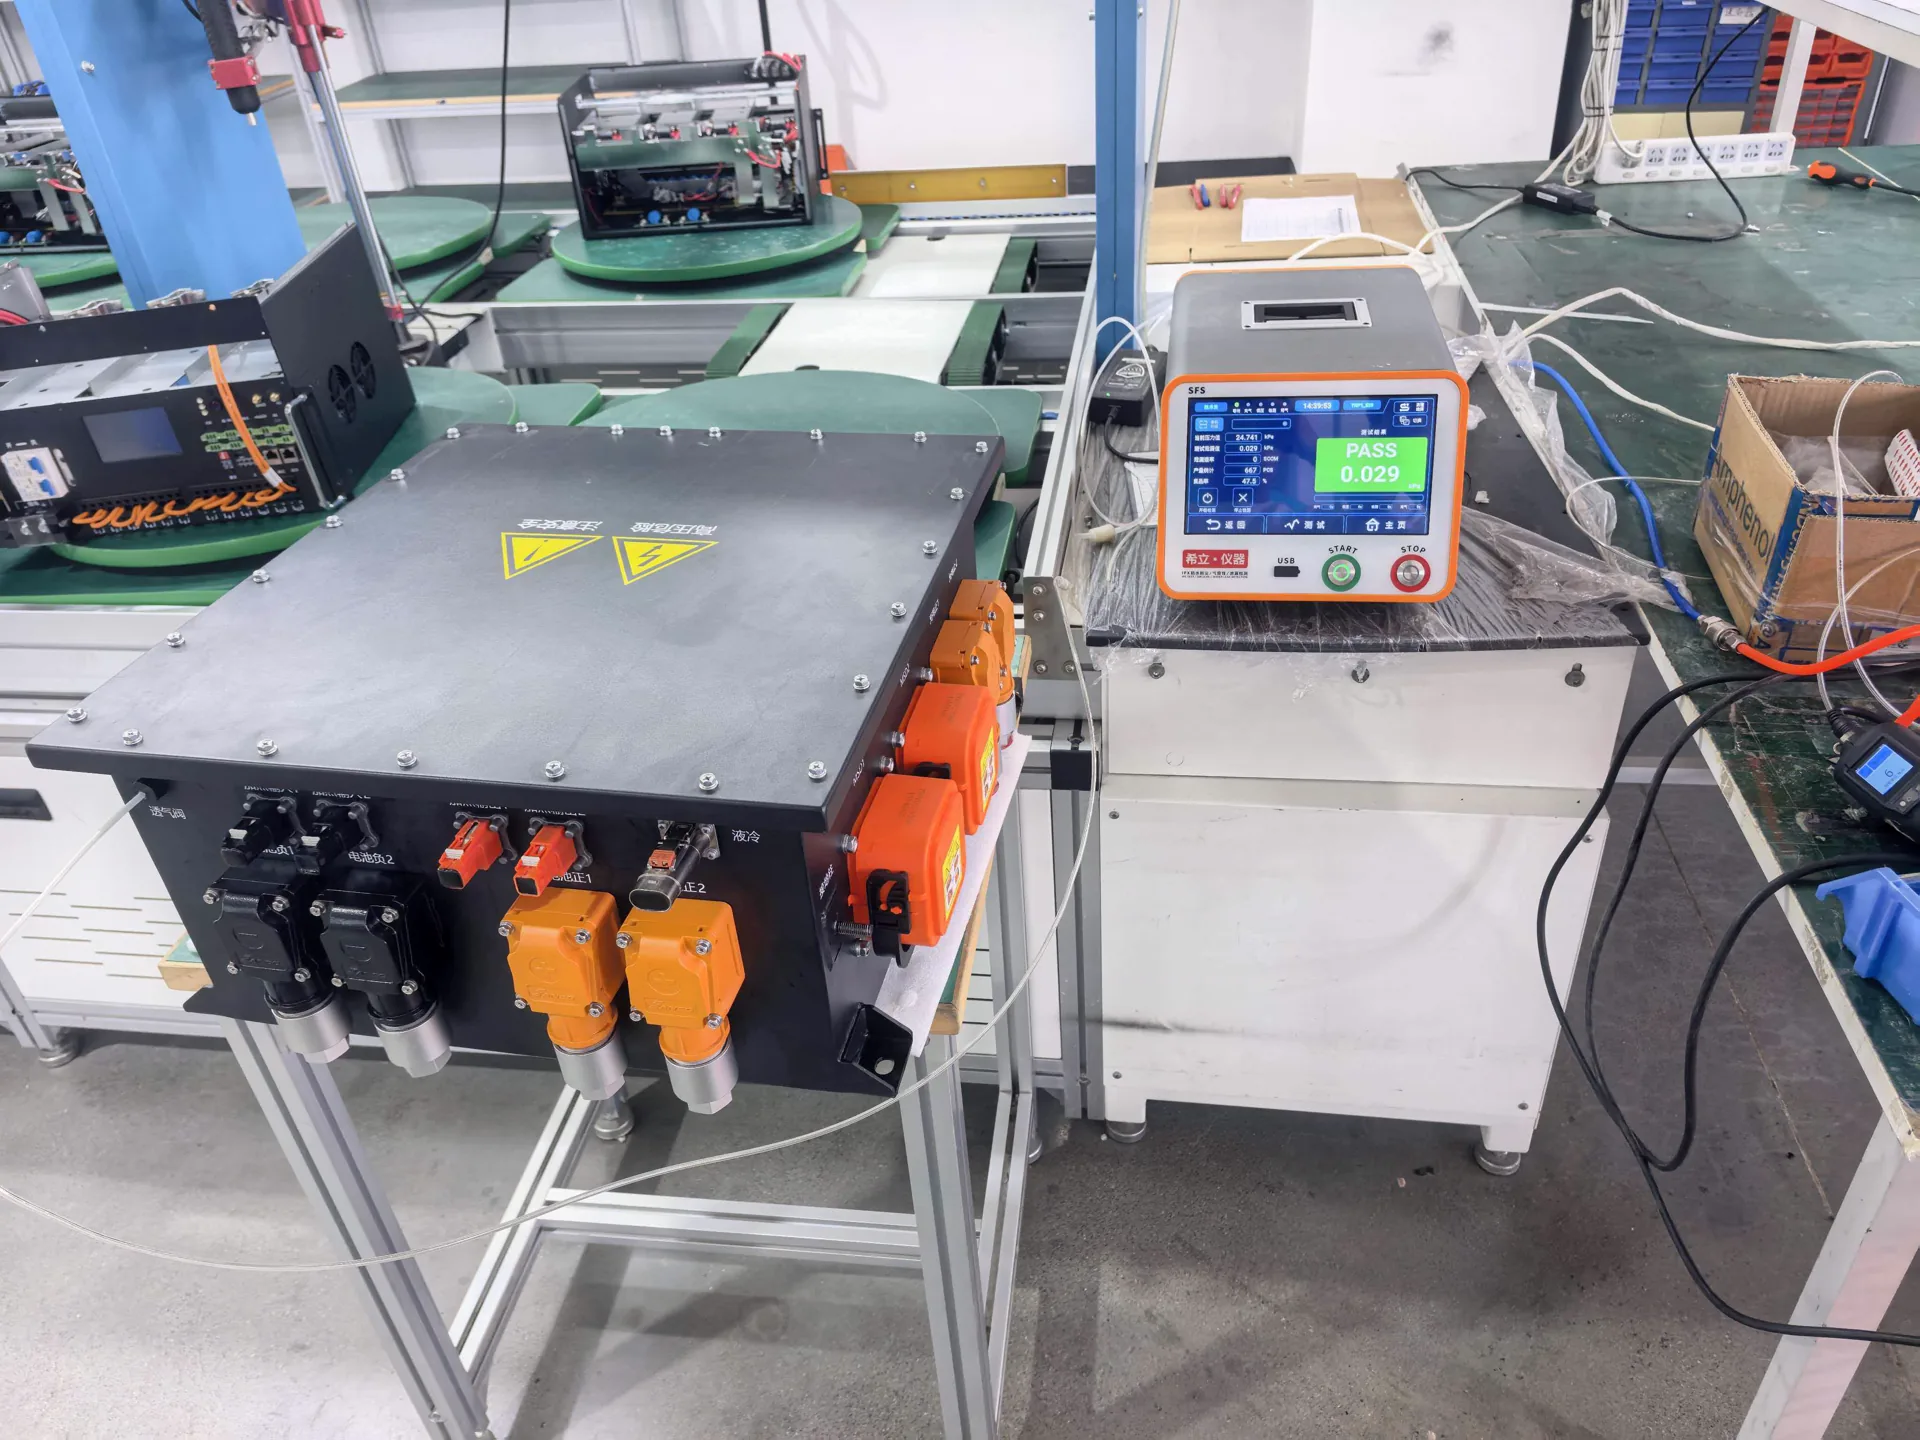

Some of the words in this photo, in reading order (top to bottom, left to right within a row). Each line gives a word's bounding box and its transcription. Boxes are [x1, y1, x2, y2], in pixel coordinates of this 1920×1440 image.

[1346, 442, 1397, 458] PASS
[1340, 465, 1400, 482] 0.029
[517, 518, 603, 532] 注意安全
[630, 521, 718, 536] 高压危险
[1384, 520, 1406, 530] 主页
[1328, 544, 1358, 554] START
[1400, 545, 1426, 553] STOP
[1277, 557, 1296, 565] USB
[731, 829, 761, 844] 液冷
[348, 851, 395, 865] 电池负2
